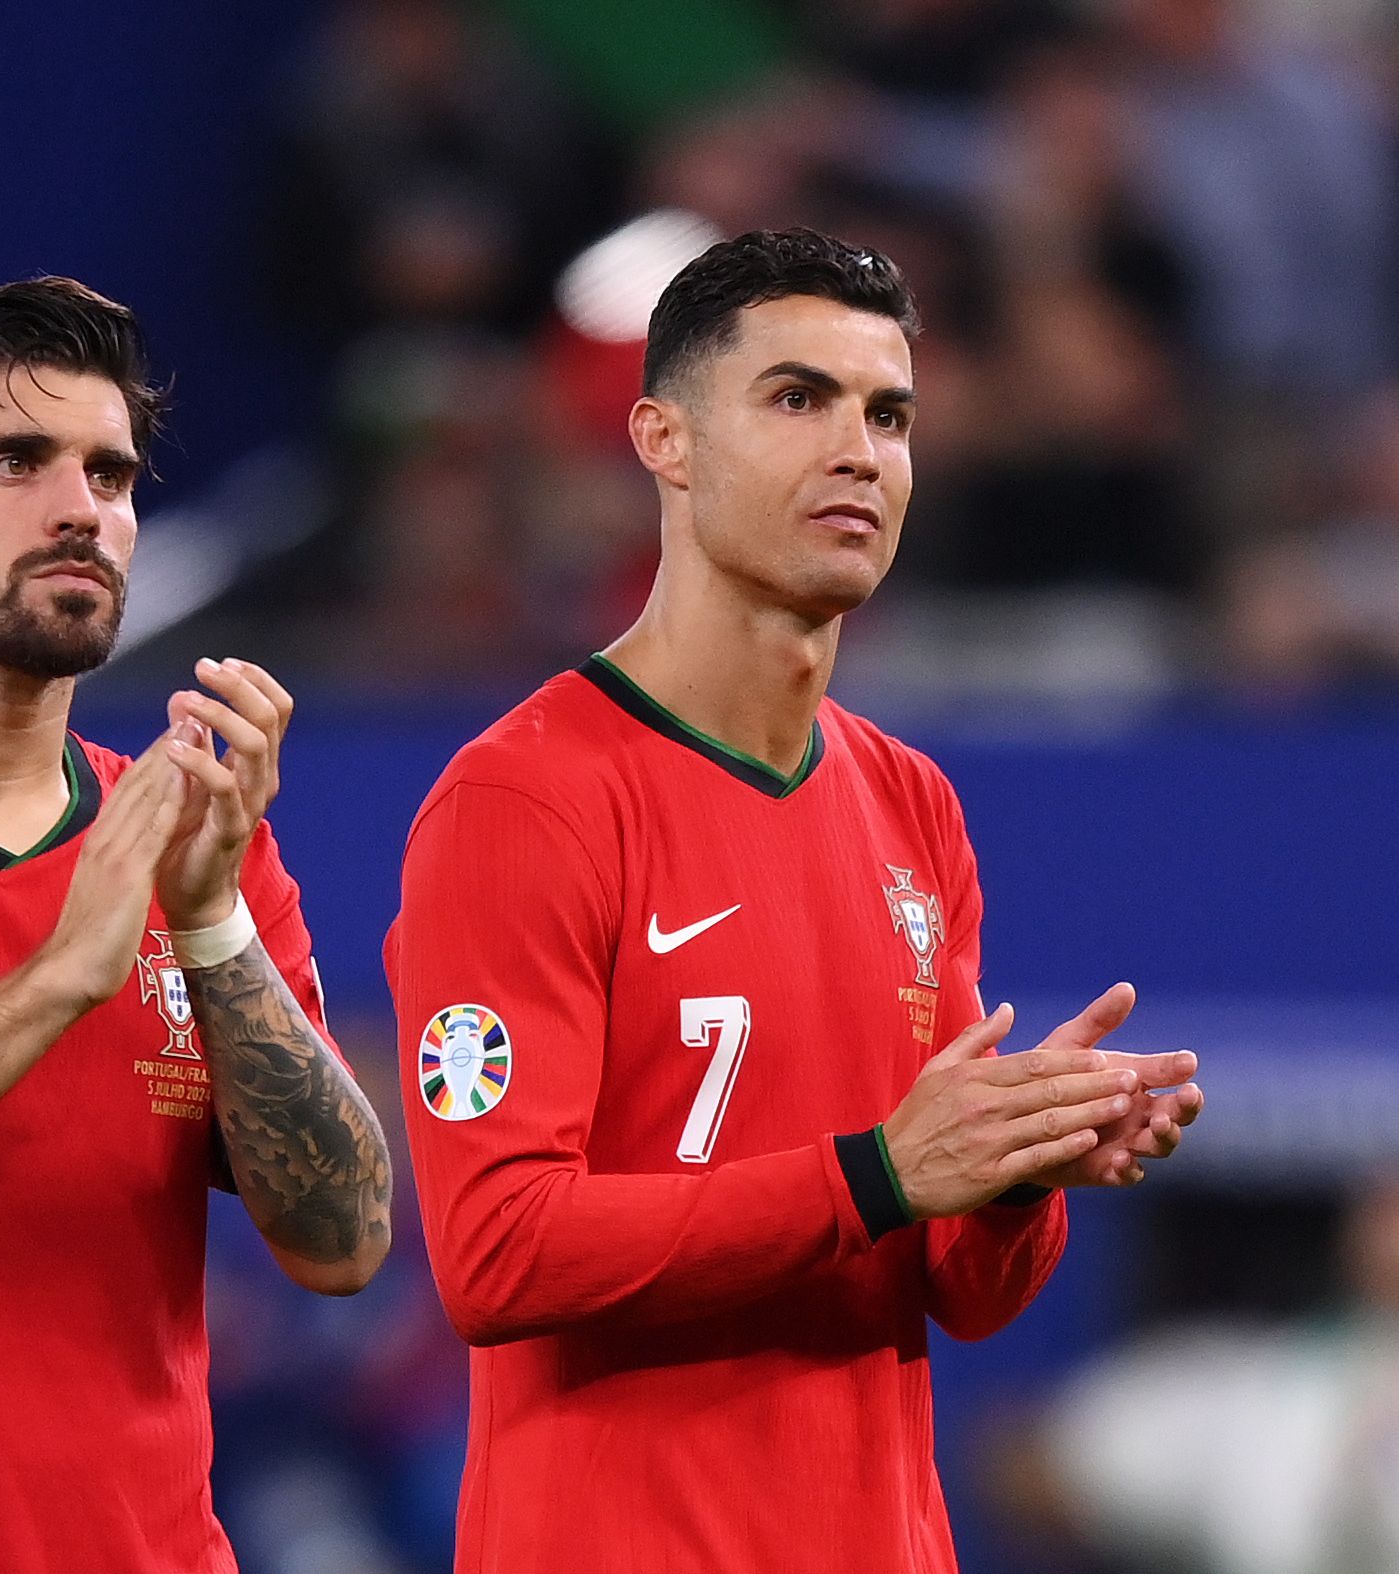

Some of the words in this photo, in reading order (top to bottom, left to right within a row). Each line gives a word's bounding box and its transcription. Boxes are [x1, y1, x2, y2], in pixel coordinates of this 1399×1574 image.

[133, 1059, 211, 1084] PORTUGAL/FRA
[676, 995, 751, 1163] 7
[147, 1079, 154, 1095] 5
[154, 1081, 185, 1099] JULHO
[151, 1100, 204, 1120] HAMBURGO
